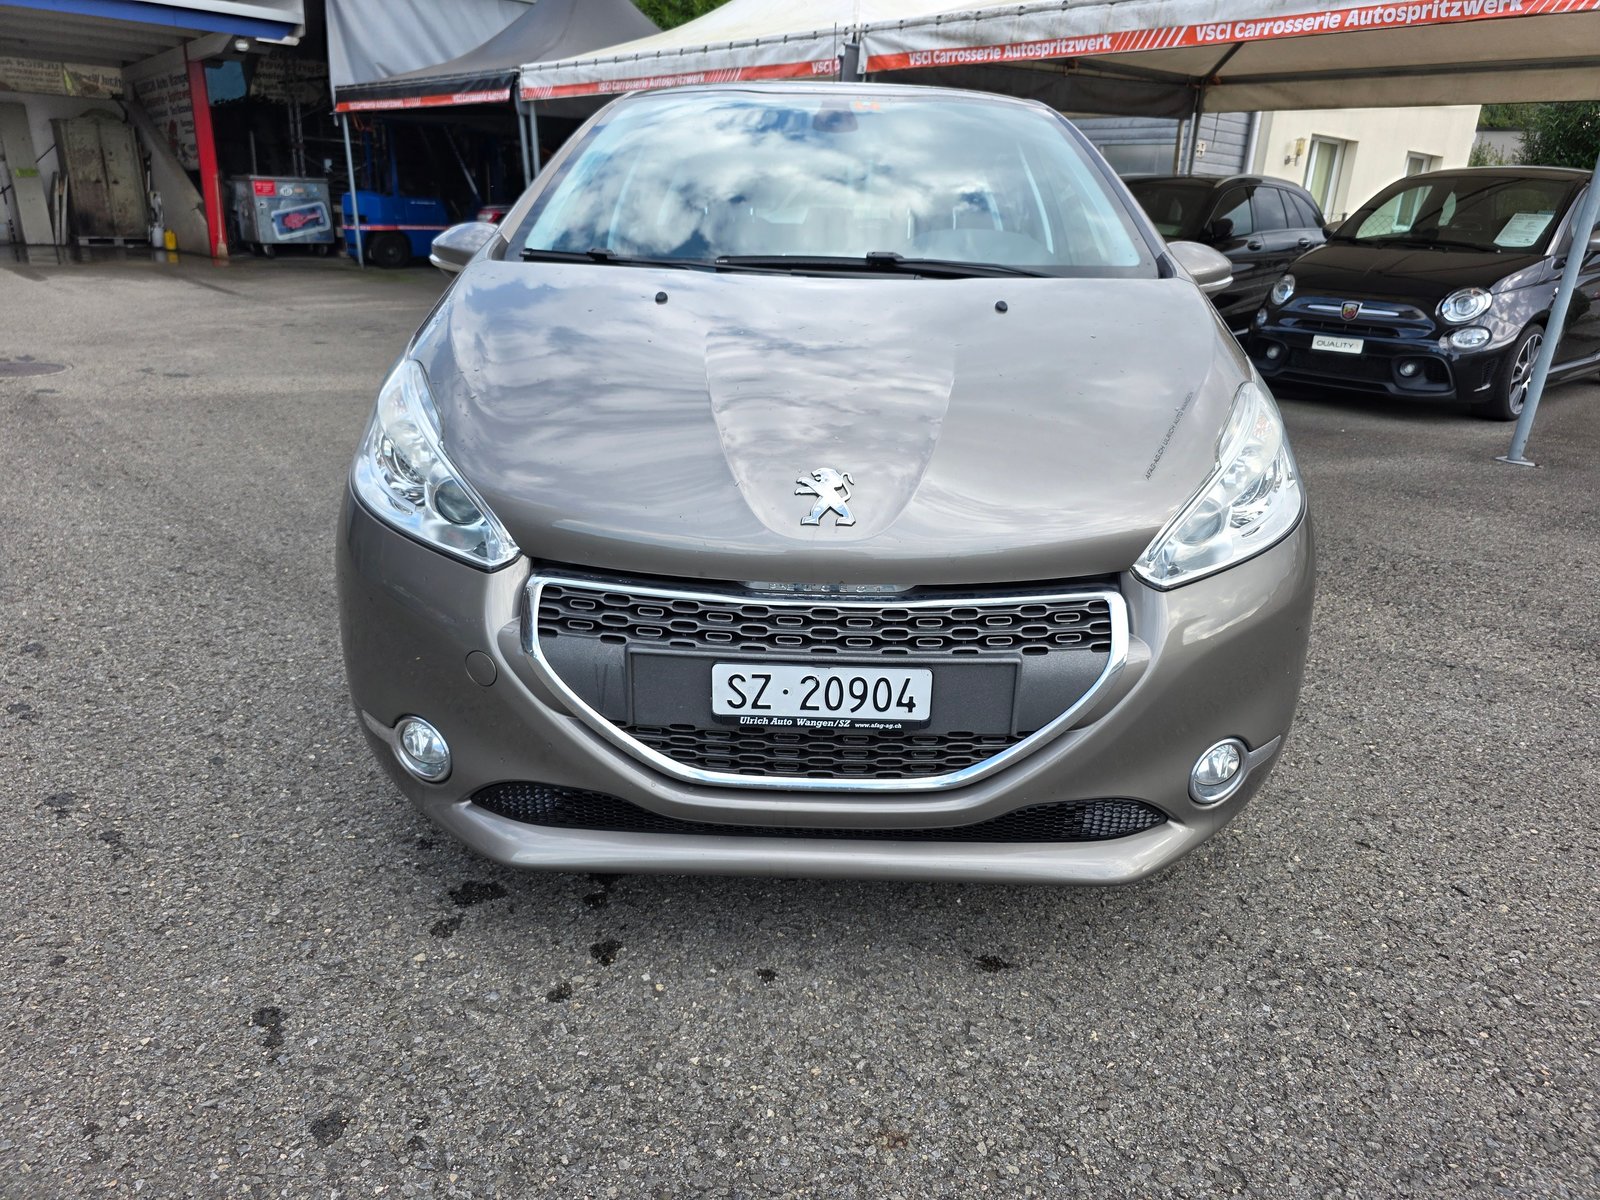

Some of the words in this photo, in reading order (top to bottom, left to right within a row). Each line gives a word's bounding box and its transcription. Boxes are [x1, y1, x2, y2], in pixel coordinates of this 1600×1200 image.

[1195, 24, 1231, 42] VSCI
[1234, 12, 1341, 39] Carrosserie
[1344, 0, 1523, 28] Autospritzwerk
[908, 50, 932, 66] VSCI
[933, 44, 1001, 64] Carrosserie
[1003, 34, 1112, 60] Autospritzwerk
[612, 77, 648, 92] Carrosserie
[649, 72, 705, 89] Autospritzwerk
[811, 60, 832, 74] VSCI
[1145, 445, 1166, 480] AFAG-AG.CH
[1162, 425, 1176, 446] ULRICH
[1174, 410, 1184, 425] AUTO
[727, 673, 772, 710] SZ
[800, 675, 917, 713] 20904
[739, 716, 769, 726] Ulrich
[770, 717, 793, 727] Auto
[796, 718, 852, 729] Wangen/SZ
[854, 722, 903, 730] www.afag-ag.ch
